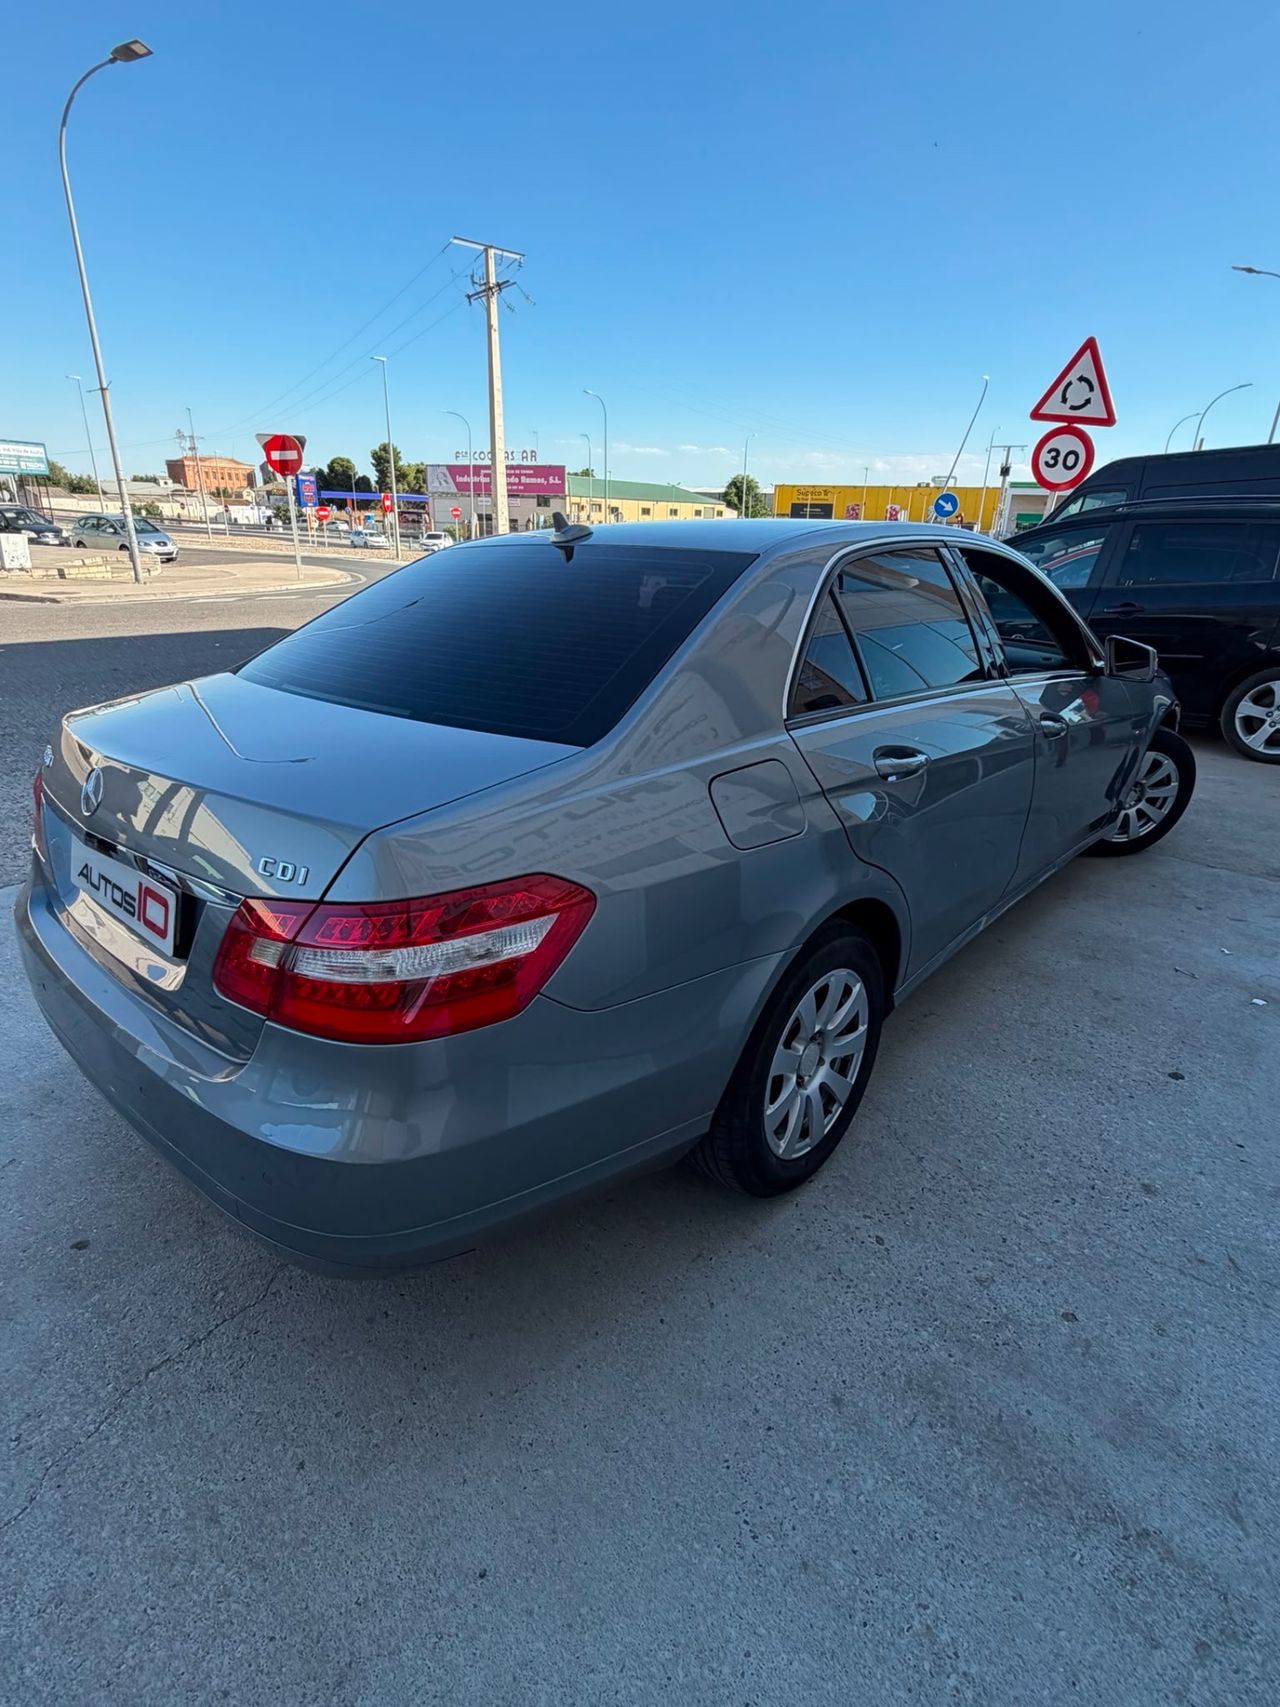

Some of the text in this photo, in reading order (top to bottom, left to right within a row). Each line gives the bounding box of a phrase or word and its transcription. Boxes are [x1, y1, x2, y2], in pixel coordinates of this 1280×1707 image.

[521, 449, 537, 462] AR
[1044, 447, 1080, 471] 30
[257, 856, 311, 886] CDI
